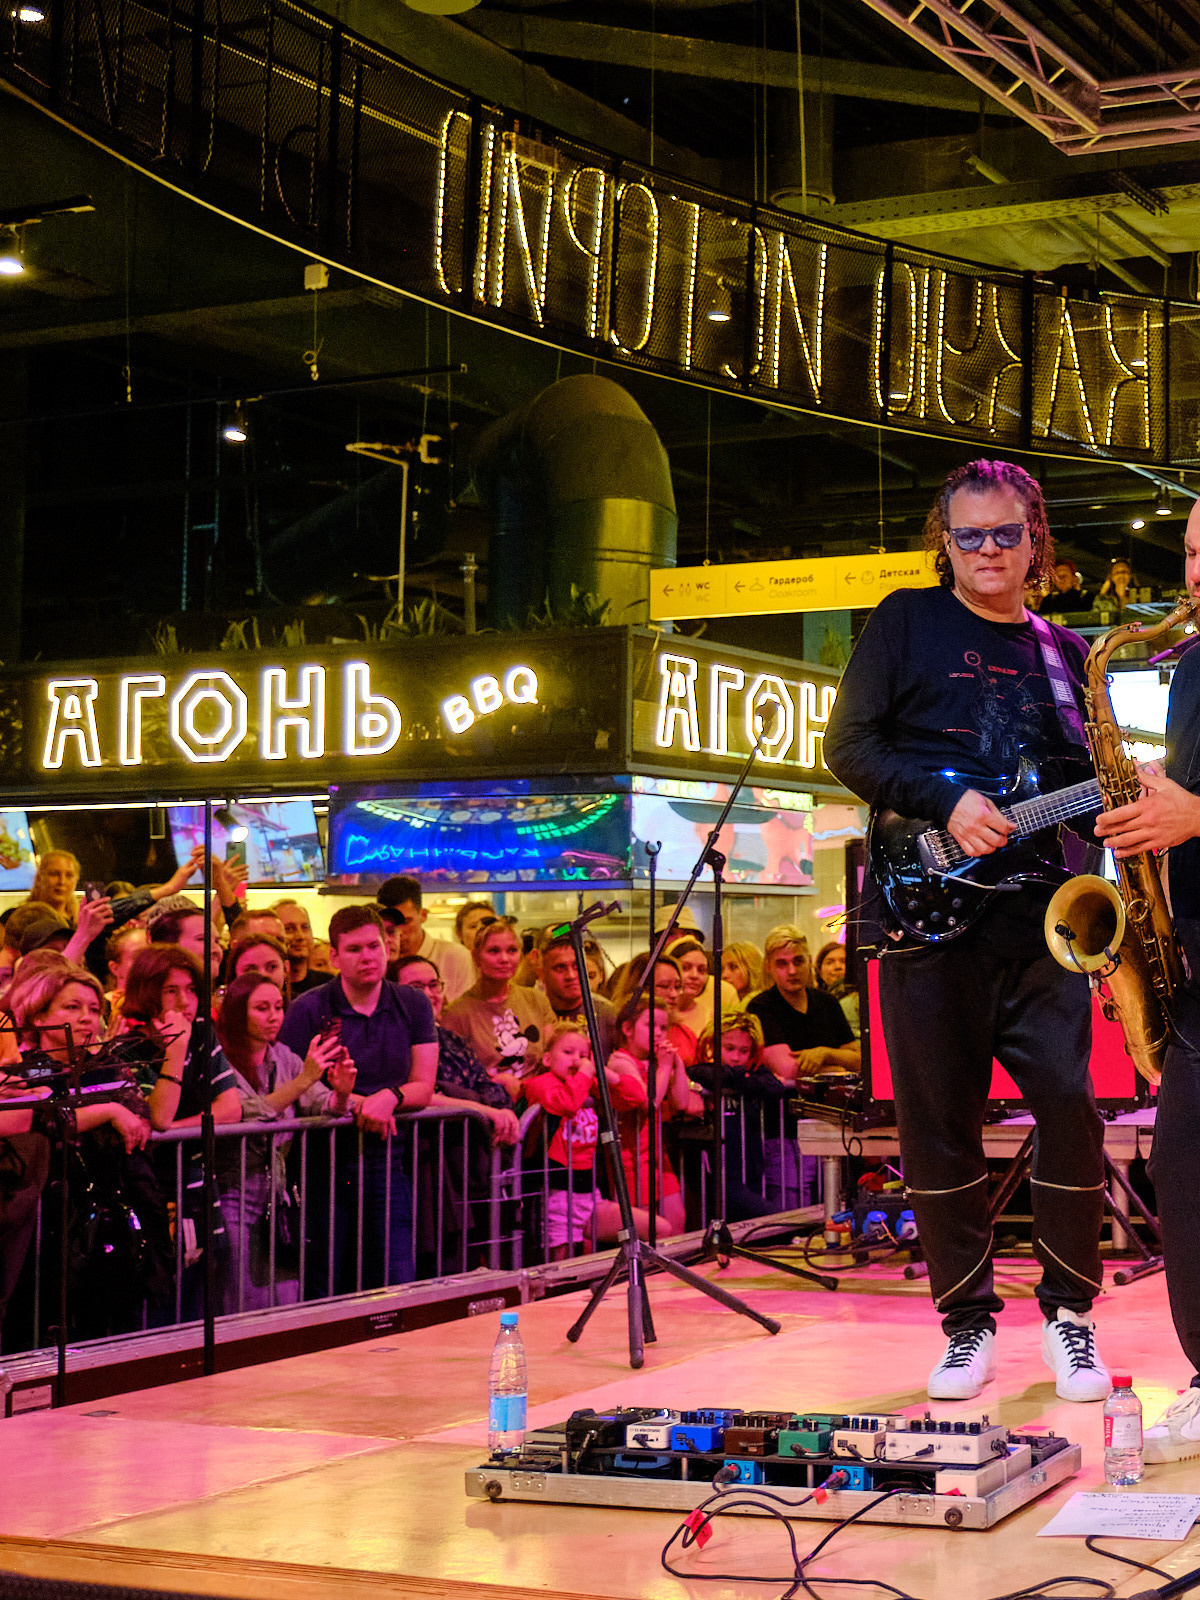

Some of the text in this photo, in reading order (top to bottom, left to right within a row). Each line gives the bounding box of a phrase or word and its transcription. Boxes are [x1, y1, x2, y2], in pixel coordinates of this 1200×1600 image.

[768, 574, 814, 586] Гардероб
[879, 568, 920, 579] Детская
[43, 661, 402, 769] АГОНЬ
[441, 665, 539, 734] BBQ
[656, 653, 838, 770] АГОН
